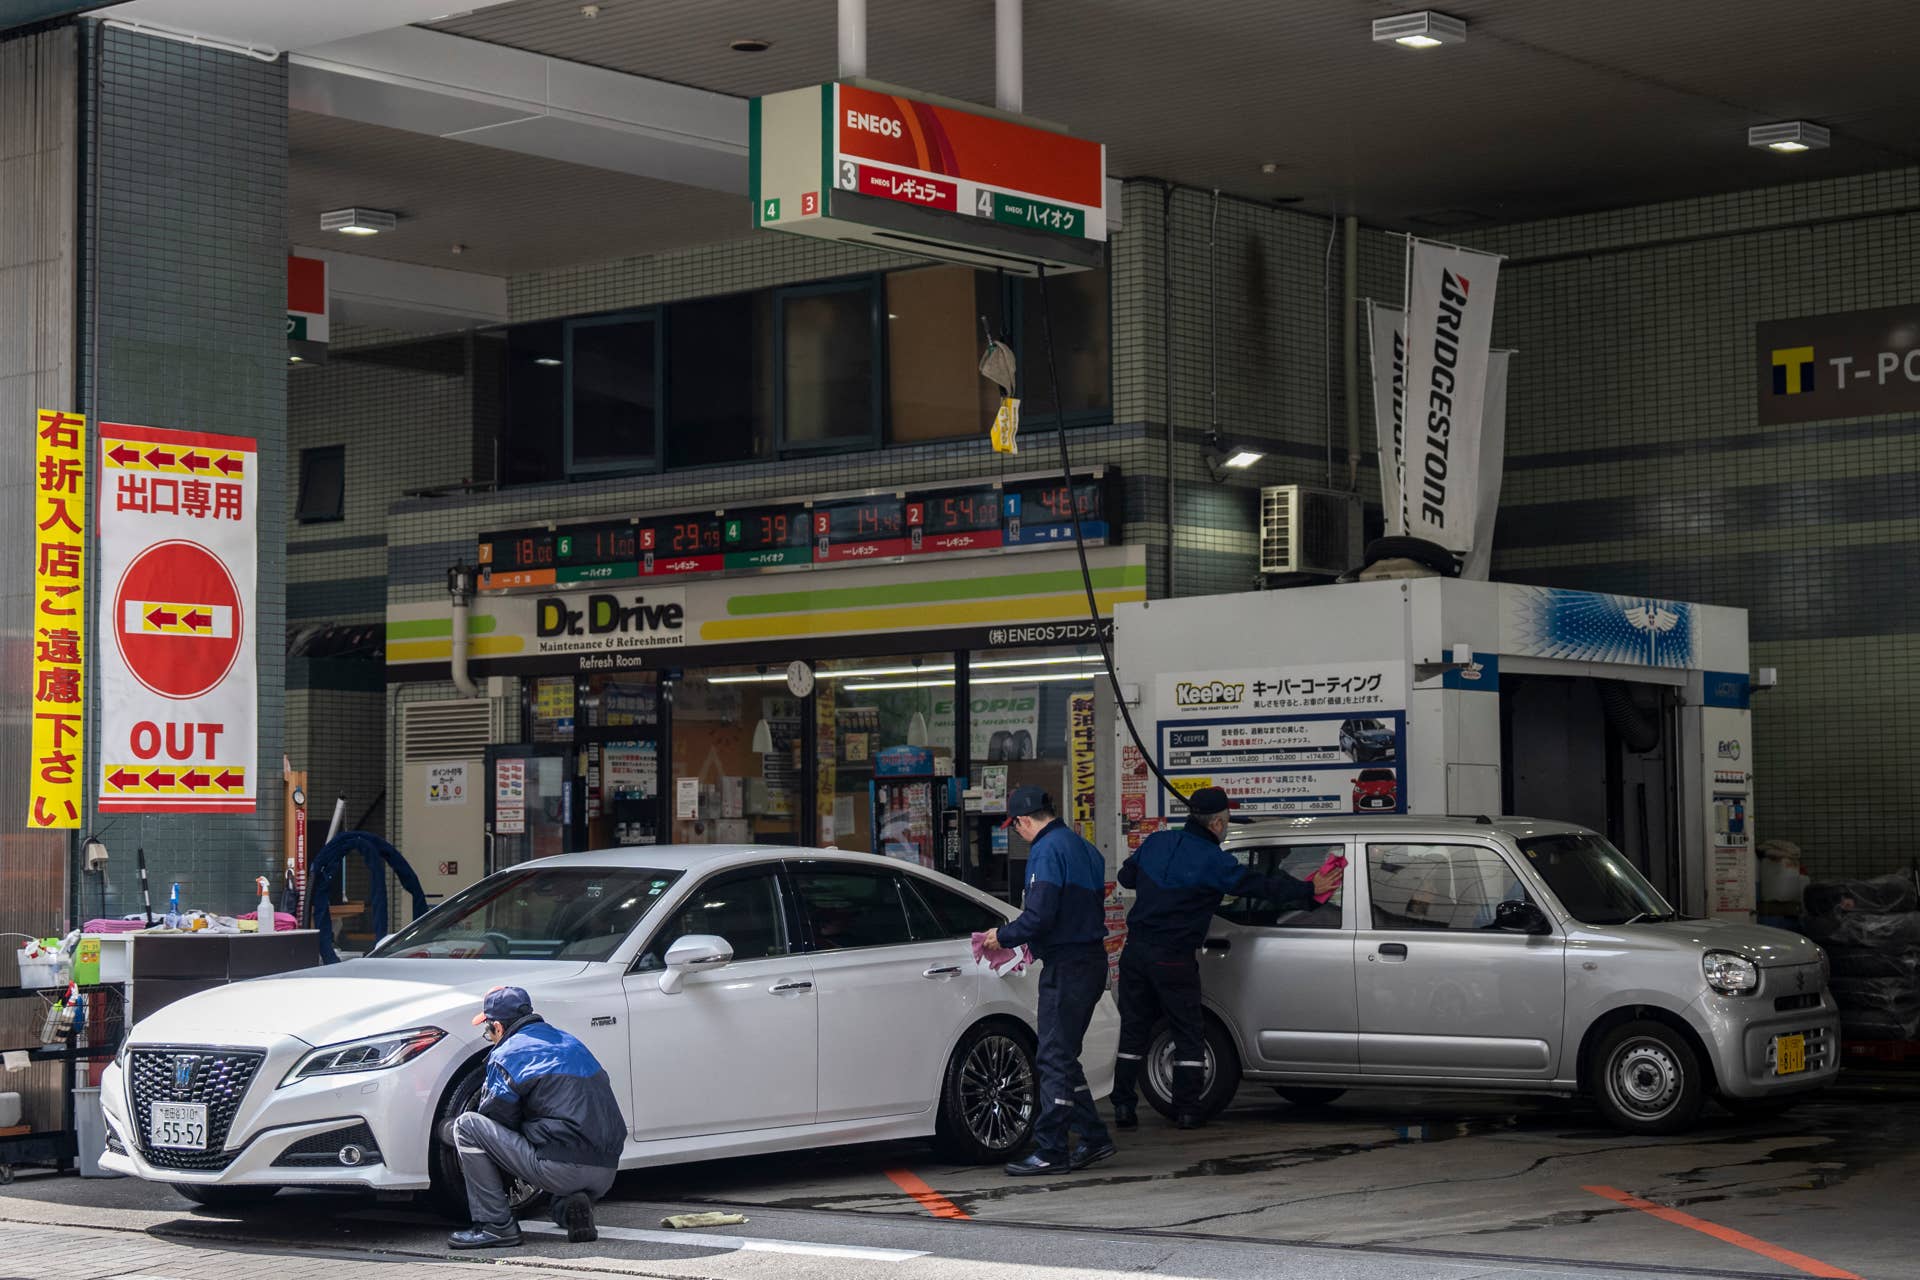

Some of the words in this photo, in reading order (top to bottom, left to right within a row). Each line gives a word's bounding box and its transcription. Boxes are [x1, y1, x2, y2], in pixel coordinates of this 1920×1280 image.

[847, 109, 902, 138] ENEOS
[841, 162, 857, 191] 3
[870, 177, 890, 188] ENEOS
[891, 176, 946, 202] レギュラー
[766, 203, 776, 217] 4
[805, 196, 814, 211] 3
[977, 191, 992, 216] 4
[1005, 205, 1023, 216] ENEOS
[1027, 204, 1075, 231] ハイオク
[1422, 268, 1468, 530] BRIDGESTONE
[116, 474, 243, 521] 出口専用
[1008, 498, 1015, 513] 1
[818, 517, 827, 532] 3
[910, 508, 919, 523] 2
[644, 532, 651, 546] 5
[729, 524, 736, 538] 4
[482, 546, 489, 557] 7
[561, 539, 568, 553] 6
[34, 412, 84, 827] 右折入店ご遠慮下さい
[540, 639, 603, 653] Maintenance
[606, 638, 614, 649] &
[617, 634, 683, 648] Refreshment
[988, 624, 1115, 645] (株)ENEOSフロンティ
[580, 655, 613, 669] Refresh
[616, 654, 642, 668] Room
[1253, 674, 1382, 698] キーパーコーティング
[130, 720, 224, 760] OUT
[163, 1121, 204, 1145] 55-52
